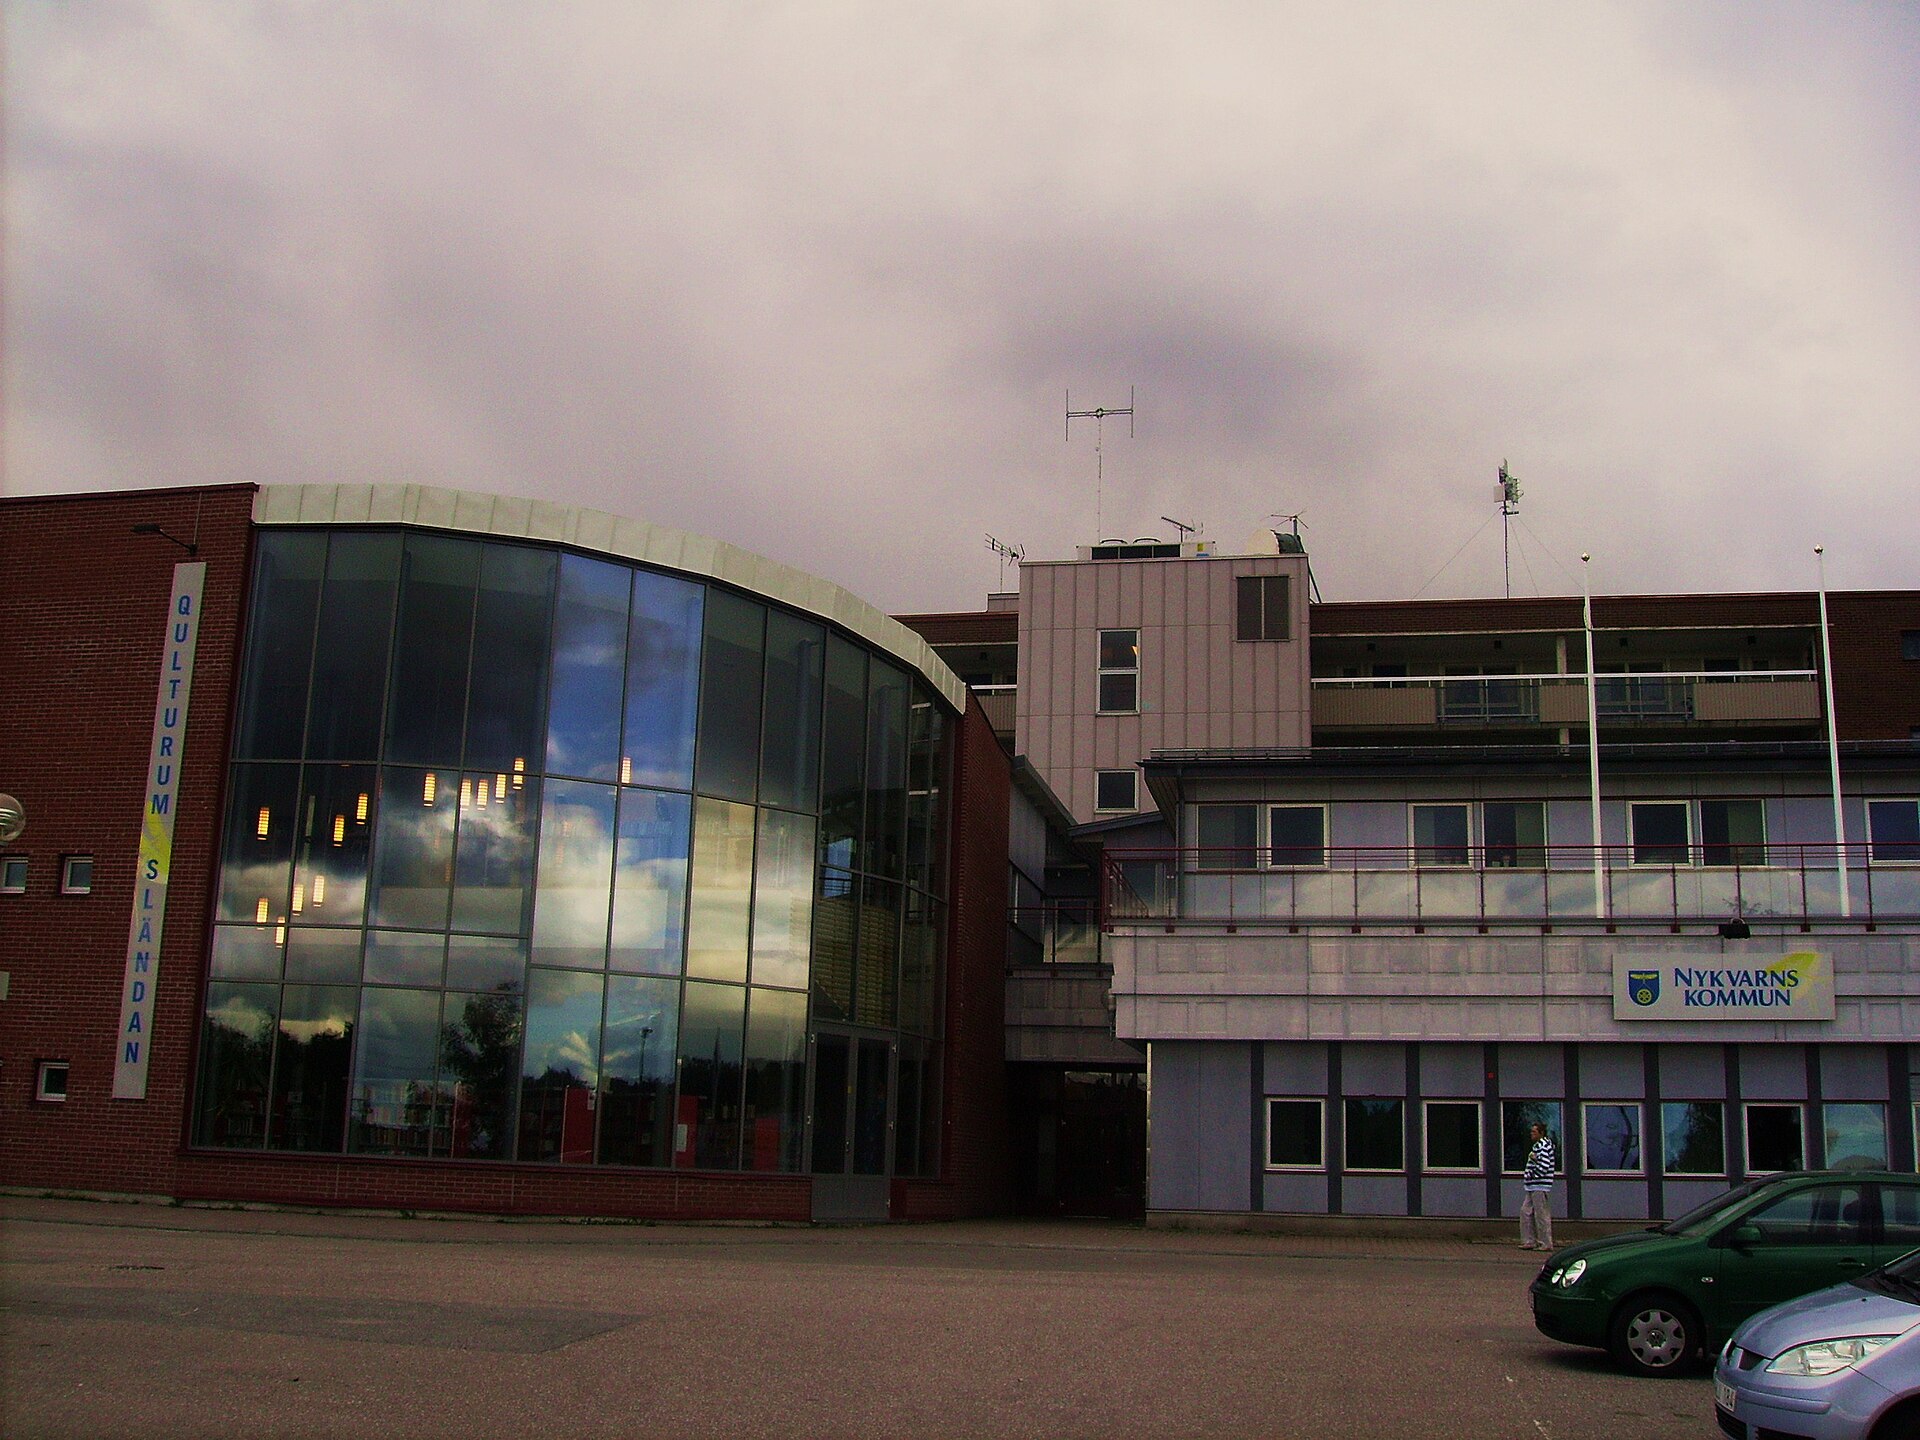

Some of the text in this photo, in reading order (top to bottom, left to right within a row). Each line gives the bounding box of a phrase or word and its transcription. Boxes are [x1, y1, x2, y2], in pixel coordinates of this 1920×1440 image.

[124, 595, 192, 1064] QULTURUM SLÄNDAN
[1674, 967, 1799, 988] NYKVARNS
[1684, 989, 1791, 1007] KOMMUN
